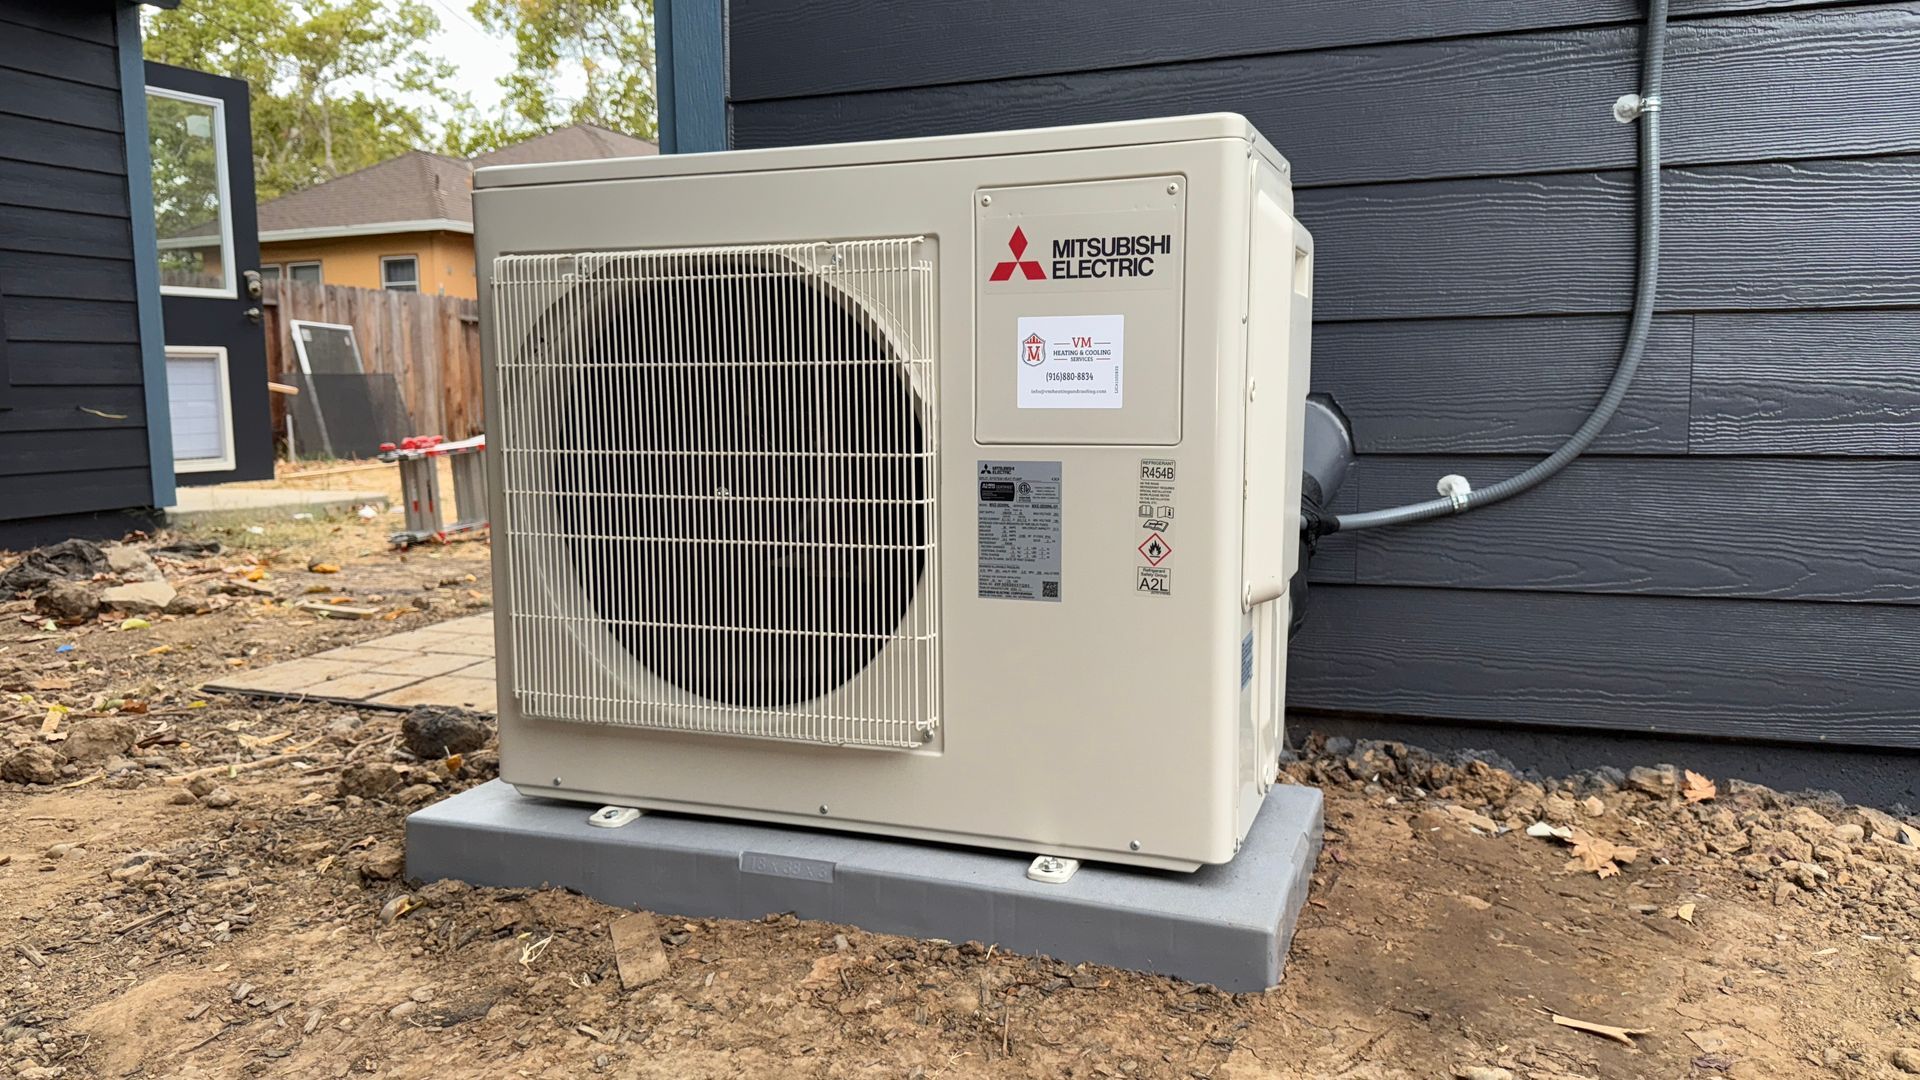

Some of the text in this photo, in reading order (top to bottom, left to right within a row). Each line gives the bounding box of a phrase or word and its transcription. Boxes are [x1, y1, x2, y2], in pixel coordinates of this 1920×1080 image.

[1052, 235, 1171, 258] MITSUBISHI
[1052, 257, 1154, 280] ELECTRIC
[1072, 336, 1092, 349] VM
[1045, 371, 1094, 383] (916)880-8834
[1142, 466, 1174, 480] R454B
[1139, 577, 1169, 592] A2L
